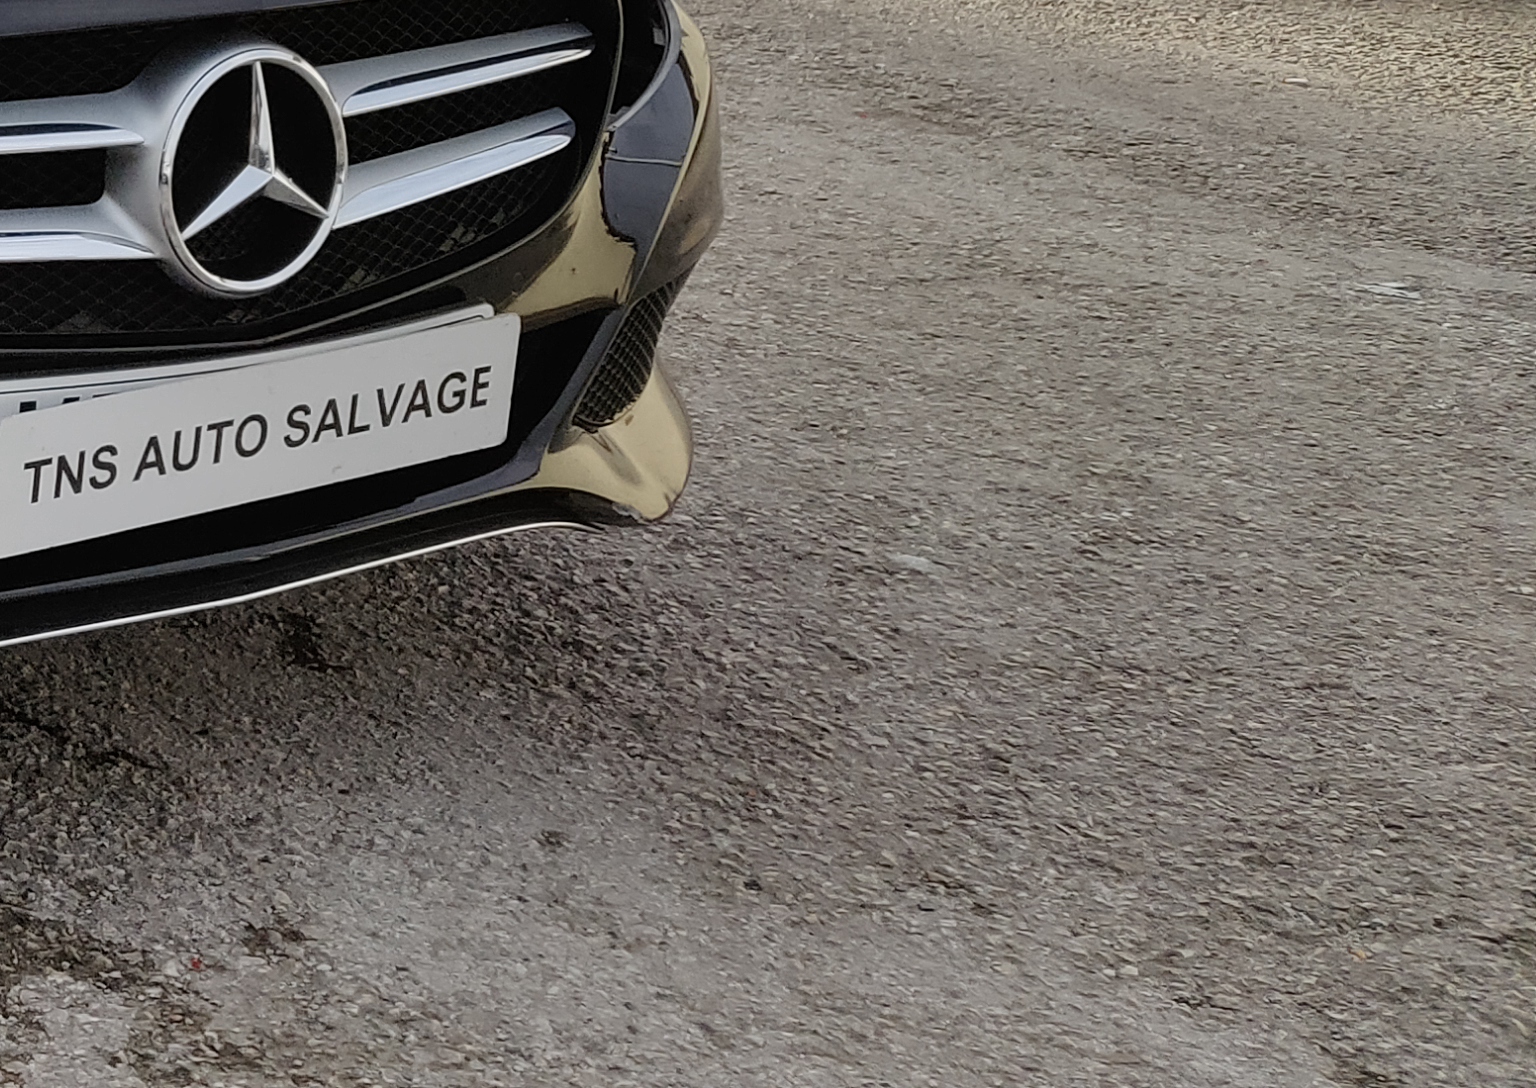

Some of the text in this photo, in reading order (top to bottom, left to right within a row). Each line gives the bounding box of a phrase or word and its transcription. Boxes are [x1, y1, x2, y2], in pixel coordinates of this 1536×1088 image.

[24, 365, 493, 504] TNS AUTO SALVAGE
